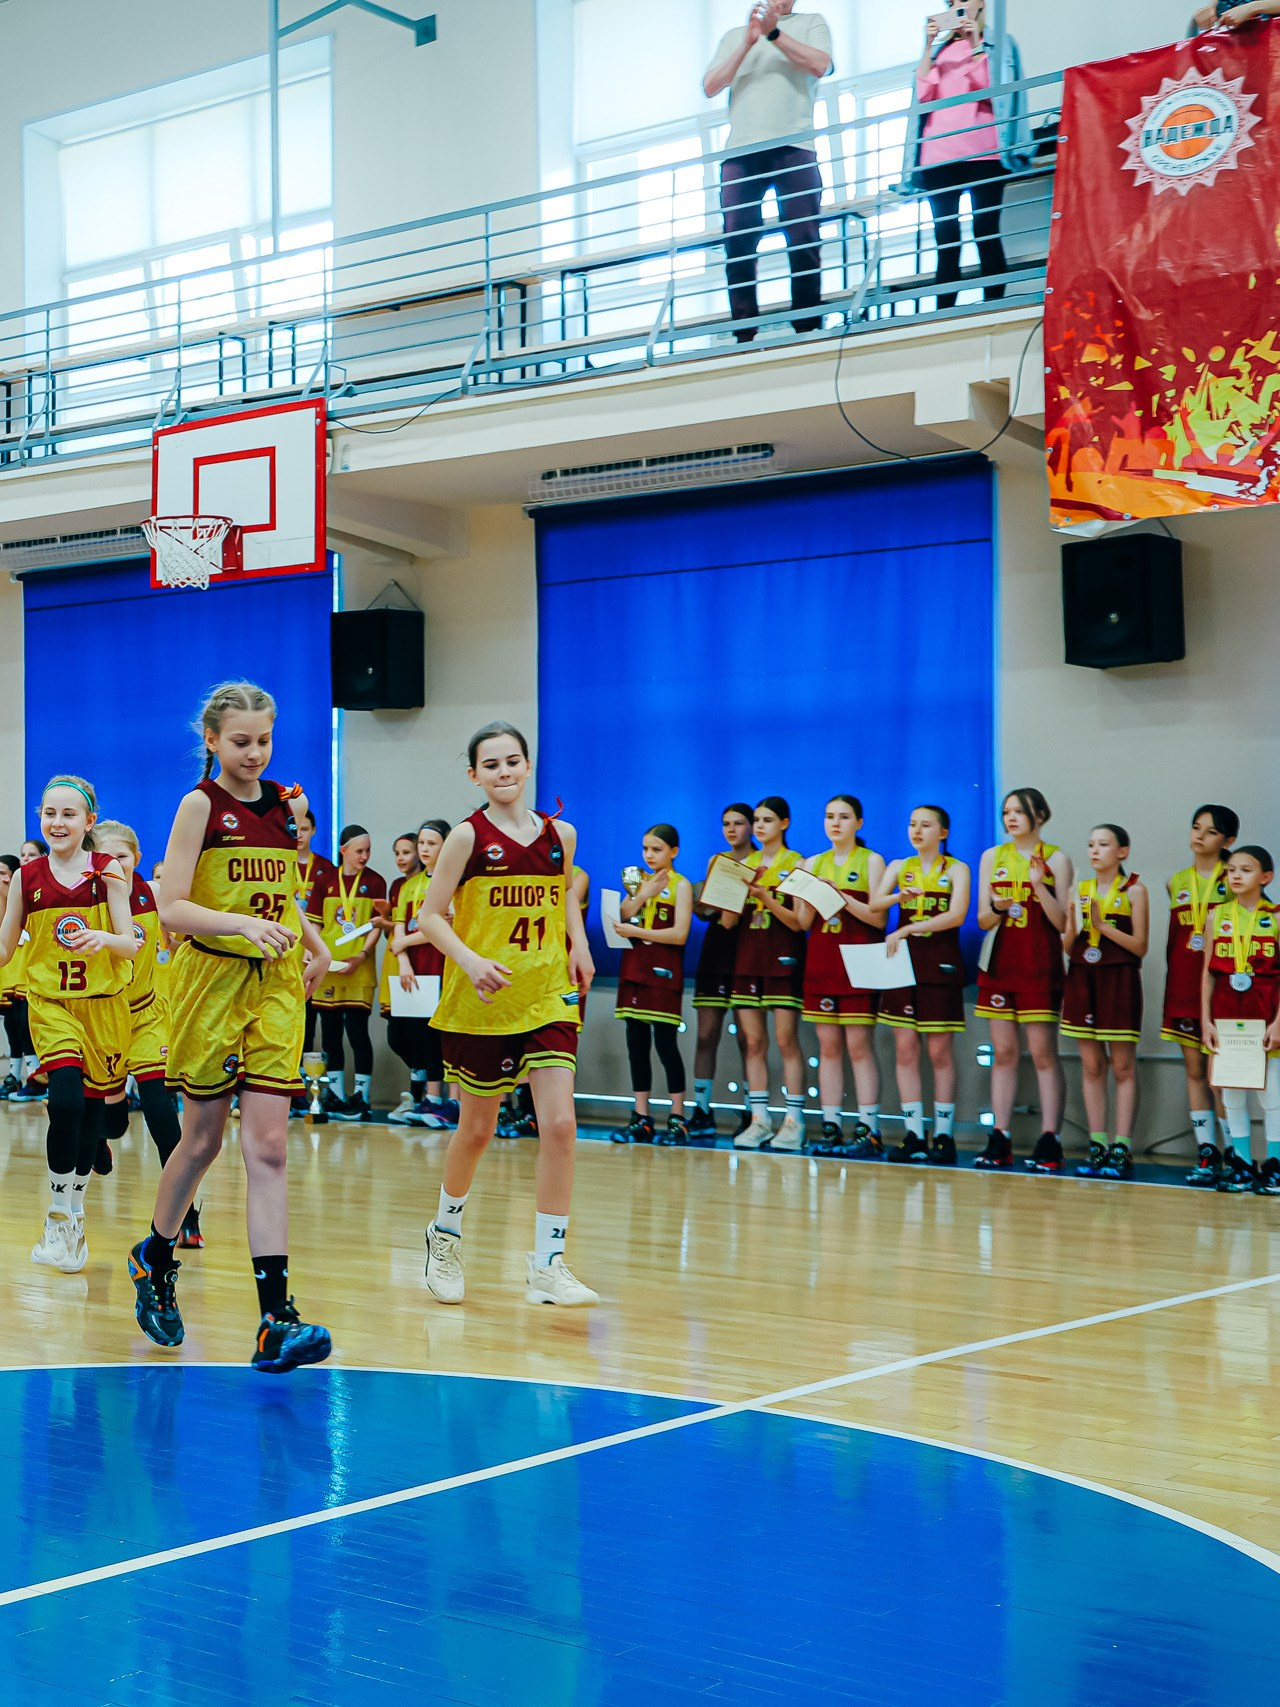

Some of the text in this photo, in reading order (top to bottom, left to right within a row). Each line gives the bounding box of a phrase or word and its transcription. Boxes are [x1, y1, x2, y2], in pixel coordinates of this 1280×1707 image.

[228, 858, 286, 883] СШОР
[249, 892, 287, 922] 35
[490, 885, 560, 907] СШОР 5
[509, 917, 546, 951] 41
[1262, 942, 1275, 957] 5
[58, 960, 87, 991] 13
